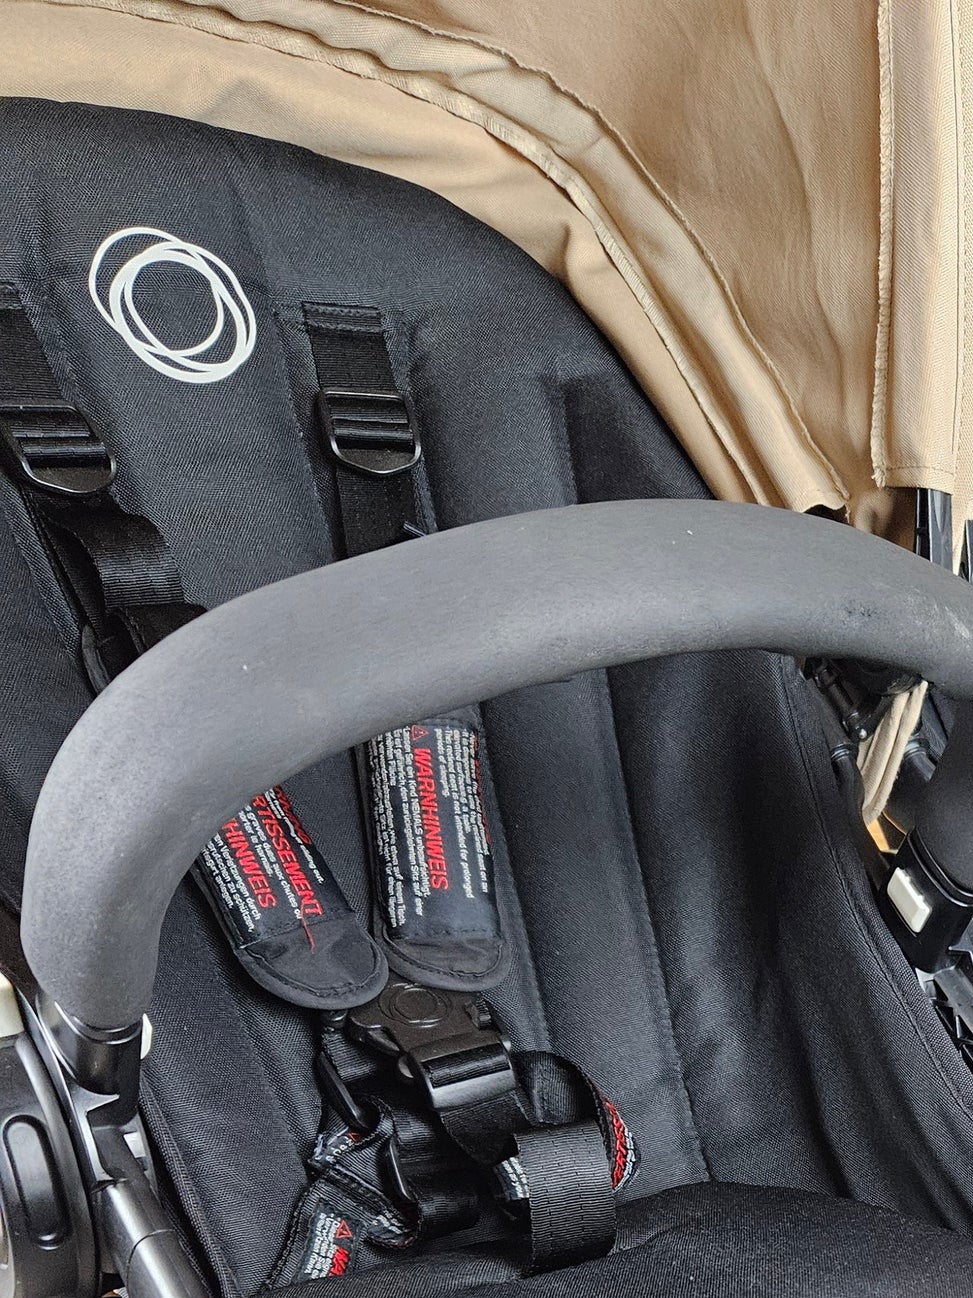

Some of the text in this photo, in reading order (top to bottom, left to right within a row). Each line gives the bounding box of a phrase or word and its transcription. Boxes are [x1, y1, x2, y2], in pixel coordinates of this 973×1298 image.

[207, 840, 231, 881] srutschen
[246, 812, 266, 841] graves
[280, 880, 297, 907] chutes
[412, 747, 450, 890] WARNHINWEIS
[220, 819, 276, 909] HINWEIS
[246, 897, 261, 920] durch
